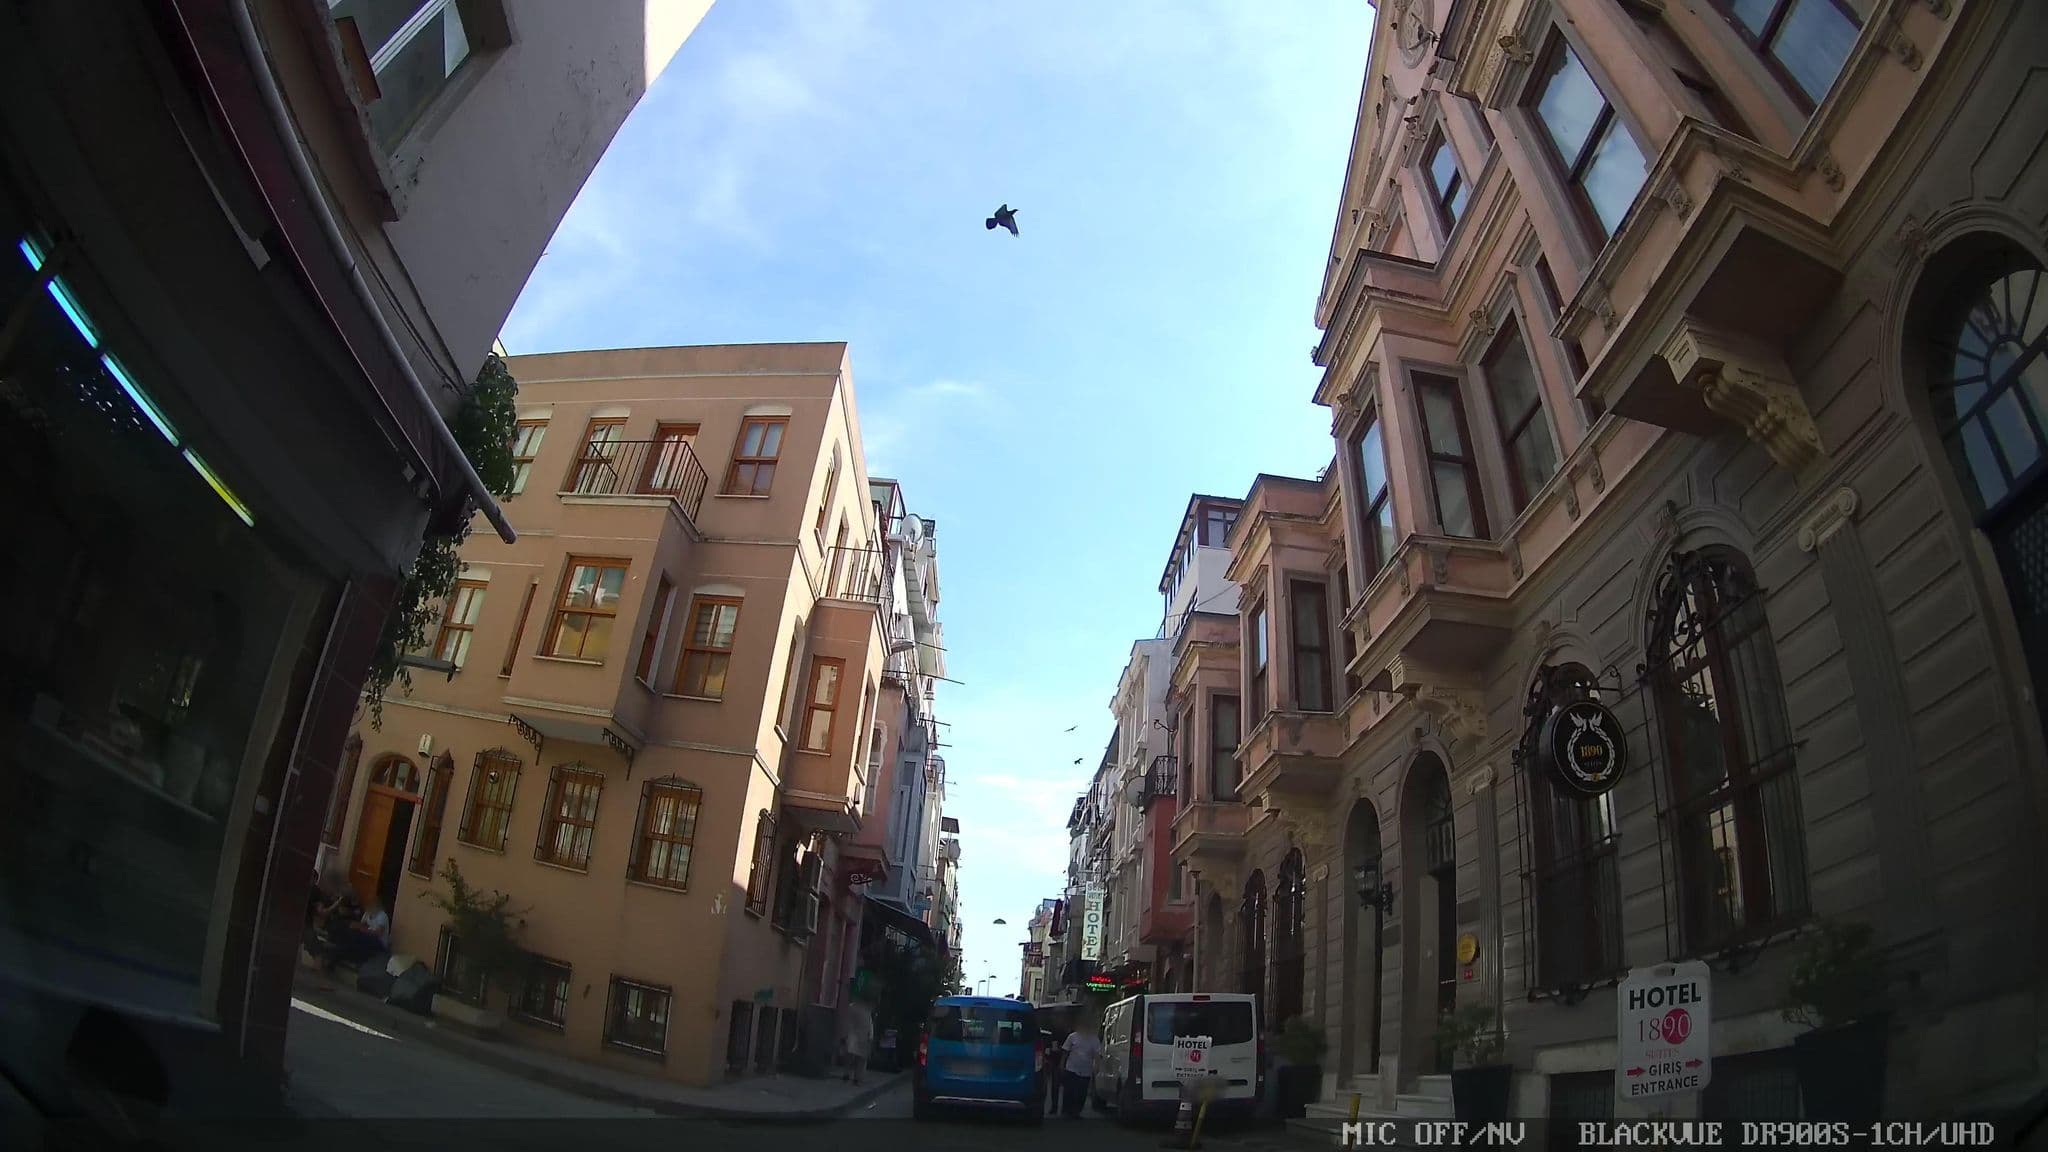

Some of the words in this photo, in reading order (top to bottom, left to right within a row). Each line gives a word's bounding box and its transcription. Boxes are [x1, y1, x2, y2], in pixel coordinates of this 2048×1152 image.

[1084, 901, 1101, 958] HOTEL
[1629, 982, 1702, 1010] HOTEL
[1638, 1013, 1692, 1042] 1890
[1177, 1040, 1207, 1049] HOTEL
[1631, 1075, 1698, 1096] ENTRANCE
